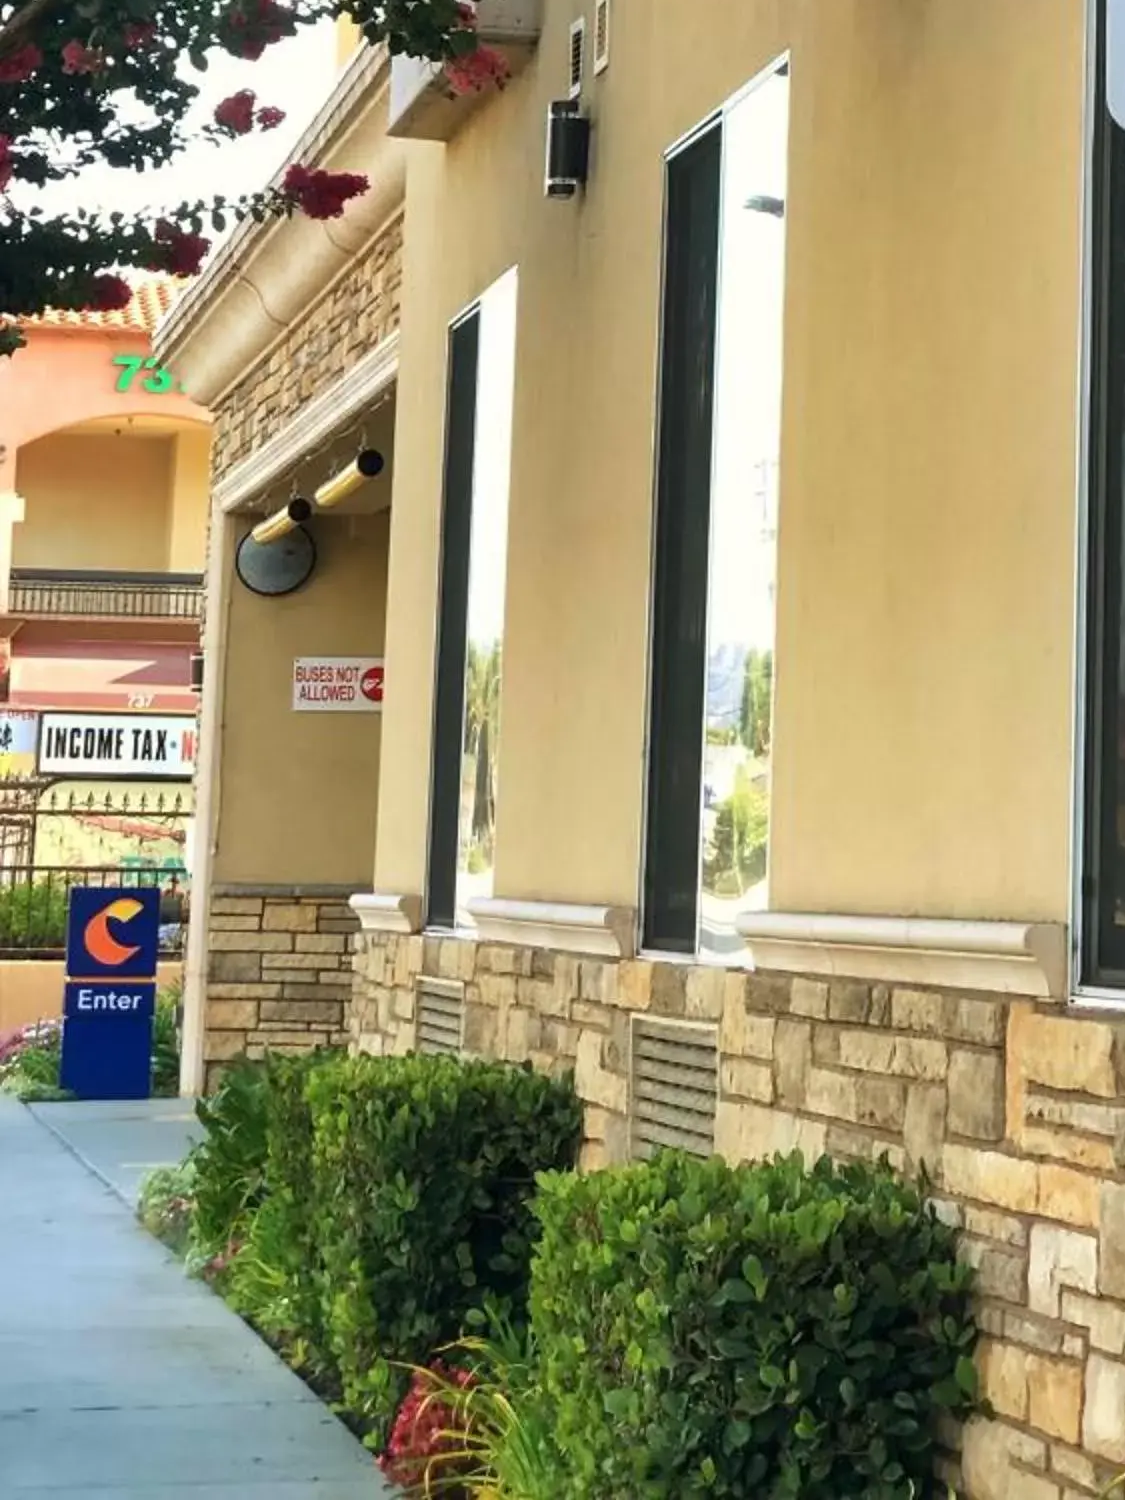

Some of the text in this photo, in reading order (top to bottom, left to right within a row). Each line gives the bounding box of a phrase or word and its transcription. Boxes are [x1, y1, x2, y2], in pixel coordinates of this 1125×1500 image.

[111, 354, 188, 393] 73
[295, 666, 360, 682] BUSES NOT
[299, 685, 355, 701] ALLOWED
[45, 727, 123, 759] INCOME
[132, 729, 167, 761] TAX
[77, 989, 142, 1010] Enter
